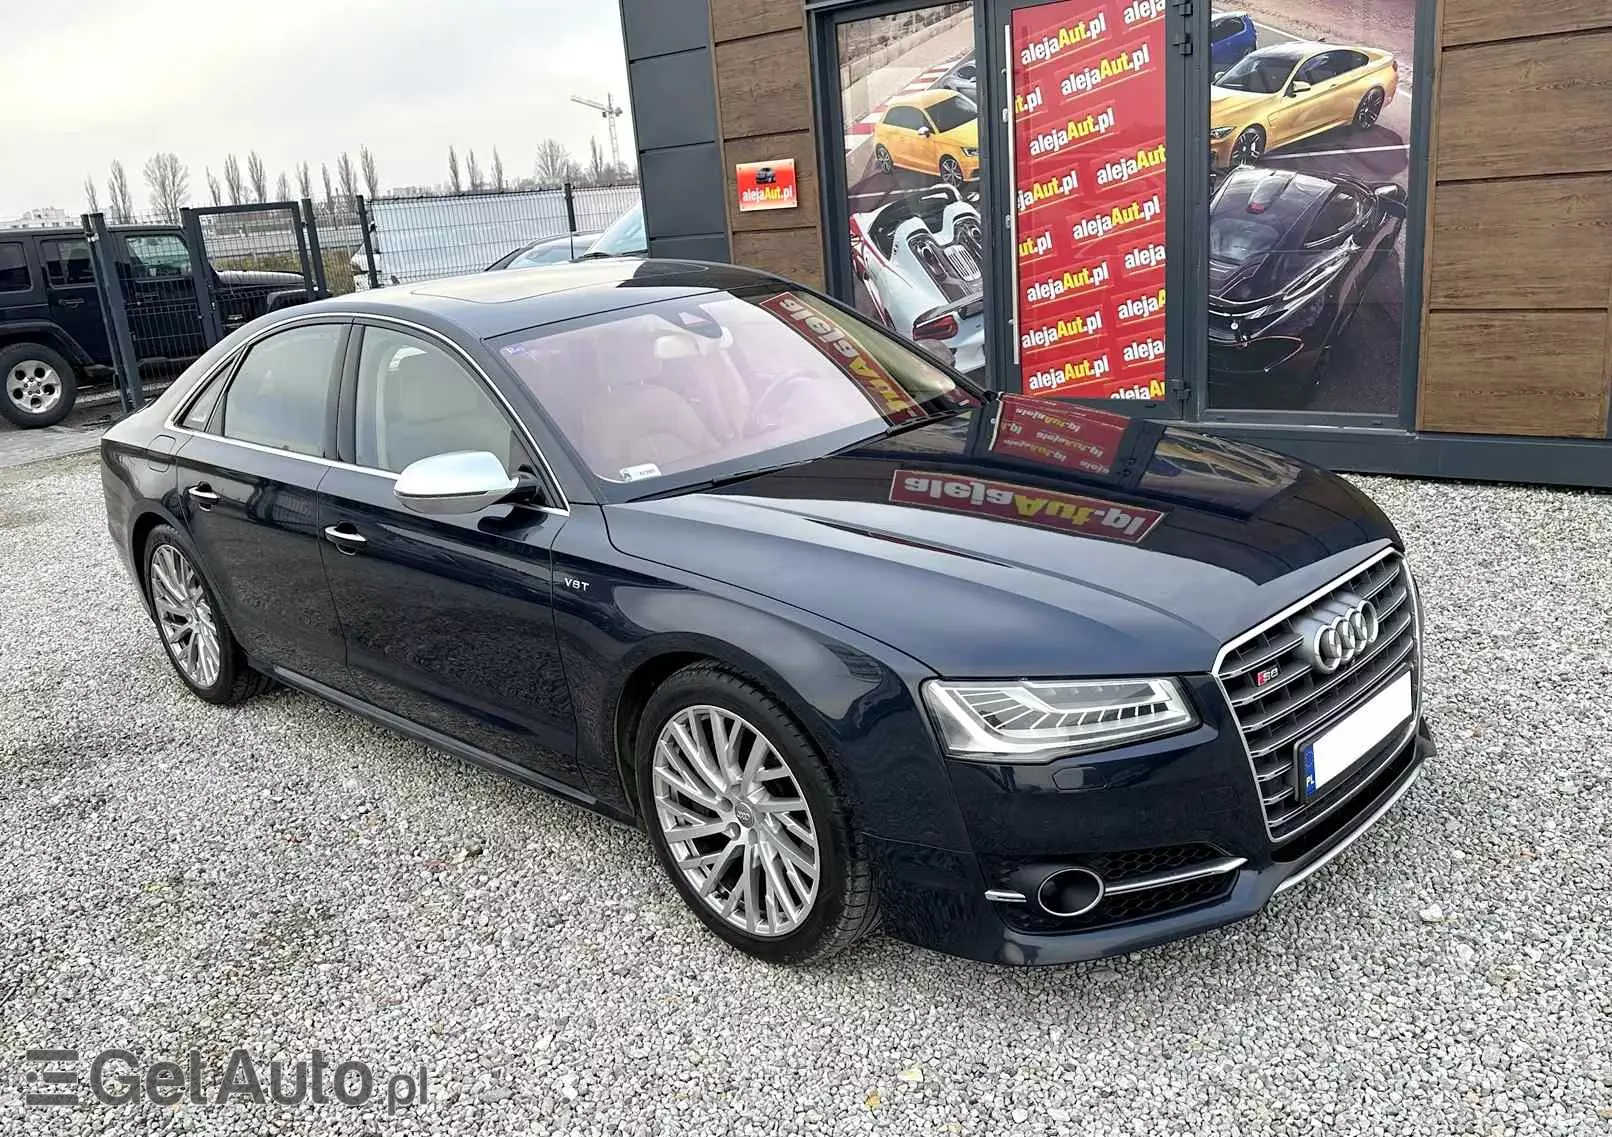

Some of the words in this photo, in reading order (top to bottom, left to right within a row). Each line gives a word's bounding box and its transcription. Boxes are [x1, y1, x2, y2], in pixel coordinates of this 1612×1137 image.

[1021, 12, 1107, 65] alejaAut.pl
[1060, 43, 1150, 96] alejaAut.pl
[1015, 86, 1043, 114] t.pl
[1029, 107, 1115, 156] alejaAut.pl
[742, 185, 793, 202] alejaAut.pl
[1072, 196, 1160, 240] alejaAut.pl
[1124, 244, 1166, 269] aleja
[1026, 262, 1109, 302] alejaAut.pl
[1021, 311, 1103, 348] alejaAut.pl
[1123, 336, 1165, 362] aleja
[1029, 355, 1109, 390] alejaAut.pl
[564, 577, 590, 592] V8T
[1306, 774, 1315, 788] PL
